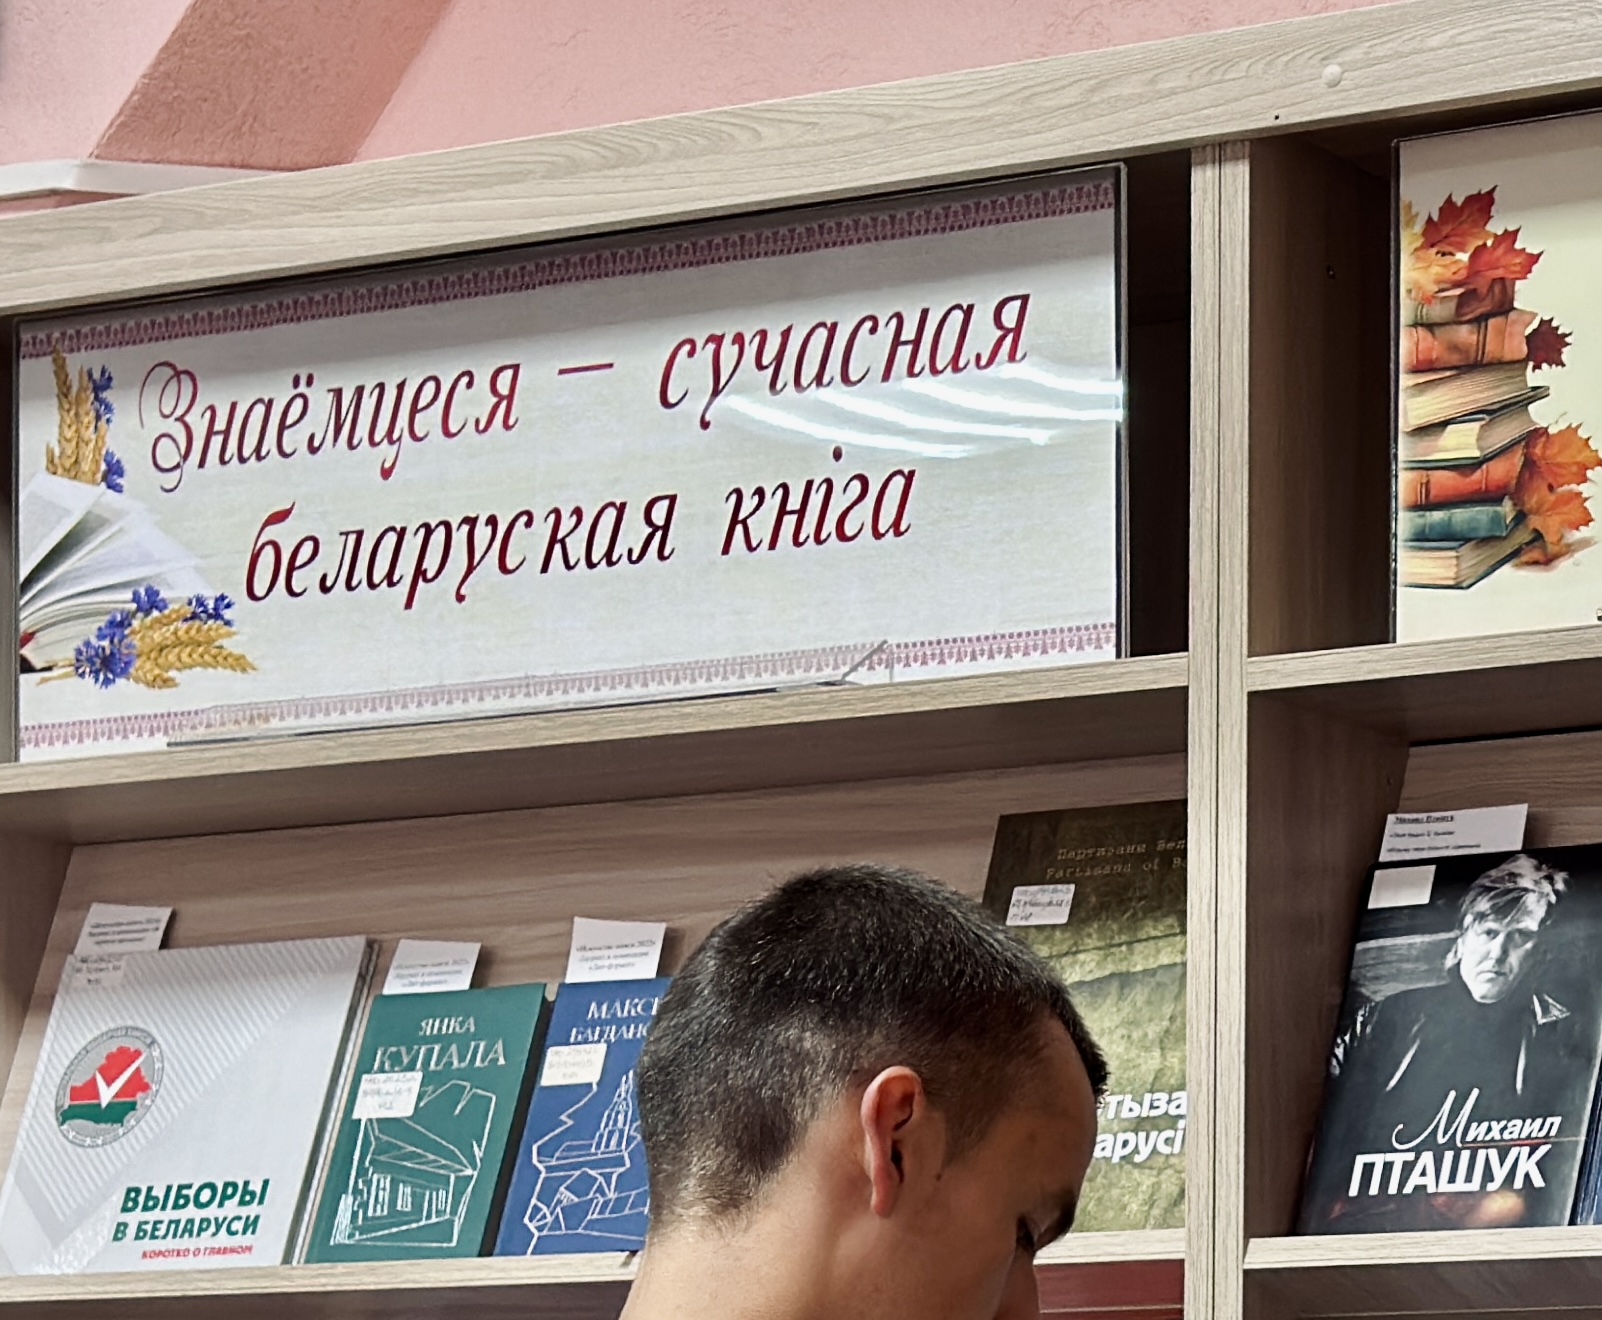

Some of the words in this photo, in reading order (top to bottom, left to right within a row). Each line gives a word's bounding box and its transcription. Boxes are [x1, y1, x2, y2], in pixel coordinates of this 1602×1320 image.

[139, 360, 521, 493] Знаёмцеся
[658, 291, 1033, 427] сучасная
[246, 492, 677, 608] беларуская
[720, 446, 917, 556] кніга
[418, 1016, 477, 1036] ЯНКА
[372, 1038, 507, 1073] КУПАЛА
[1391, 1087, 1562, 1148] Михаил
[1348, 1144, 1552, 1197] ПТАШУК
[120, 1179, 270, 1213] ВЫБОРЫ
[112, 1222, 129, 1242] В
[134, 1214, 261, 1241] БЕЛАРУСИ
[141, 1247, 191, 1260] КОРОТКО
[193, 1246, 202, 1257] О
[203, 1244, 254, 1257] ГЛАВНОМ
